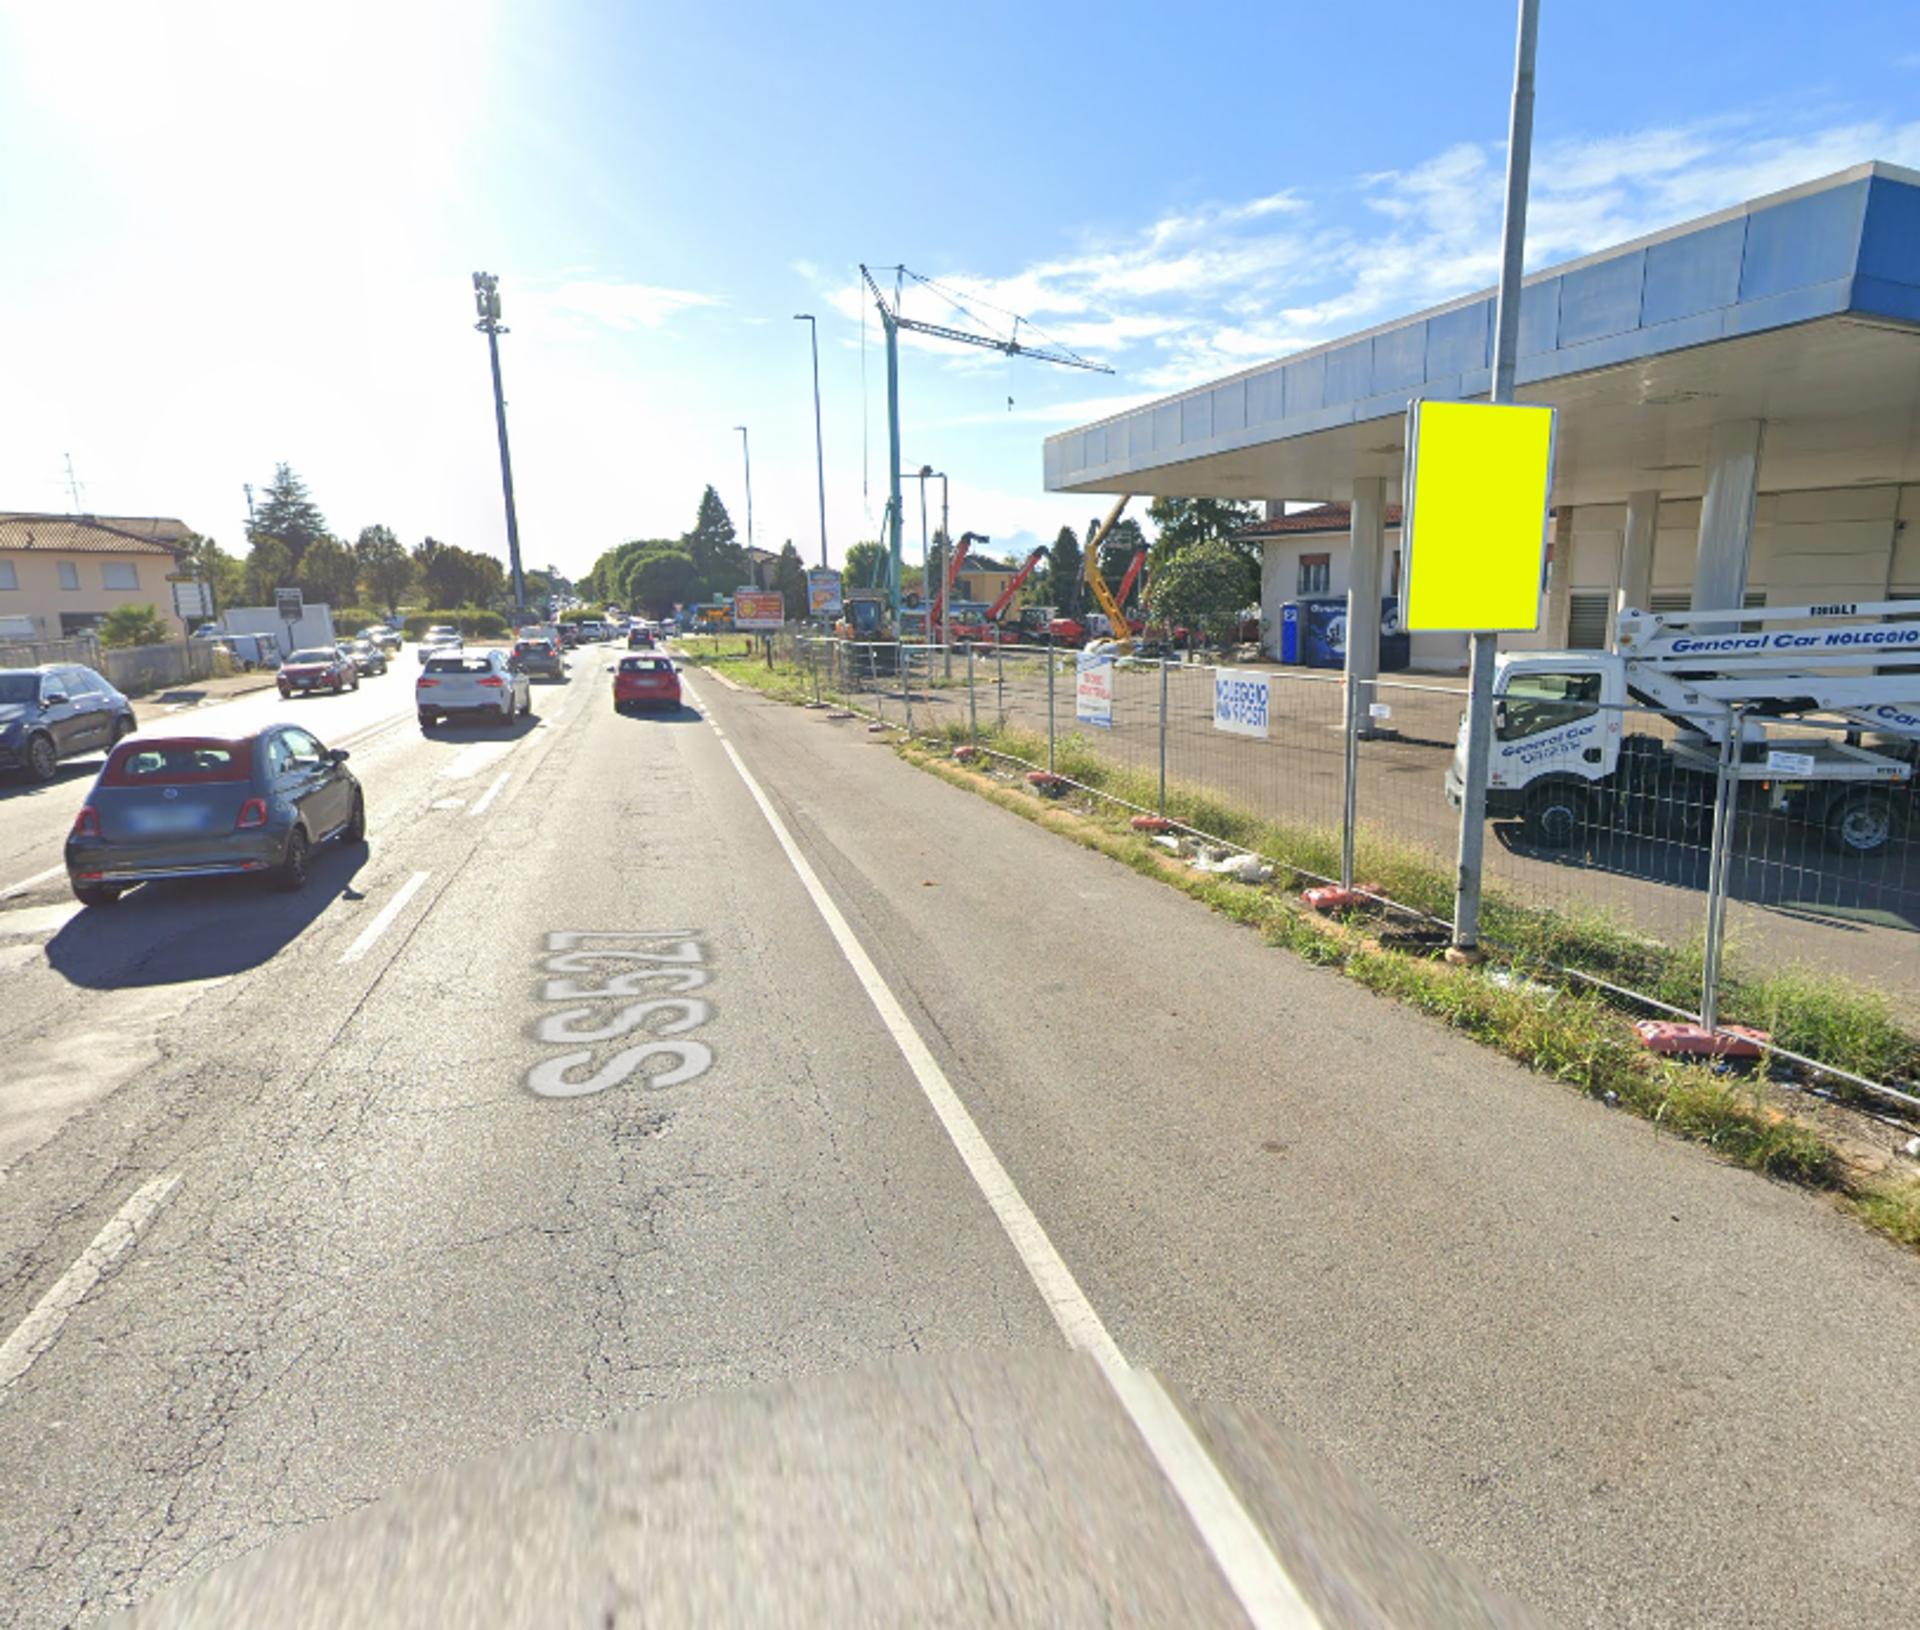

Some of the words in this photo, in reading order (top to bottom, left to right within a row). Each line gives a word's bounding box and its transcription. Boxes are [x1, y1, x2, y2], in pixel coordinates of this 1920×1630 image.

[1672, 634, 1770, 653] General
[1774, 633, 1822, 649] Car
[1825, 630, 1919, 646] NOLEGGIO
[1502, 732, 1564, 757] General
[1566, 725, 1597, 740] Car
[528, 930, 712, 1098] SS527
